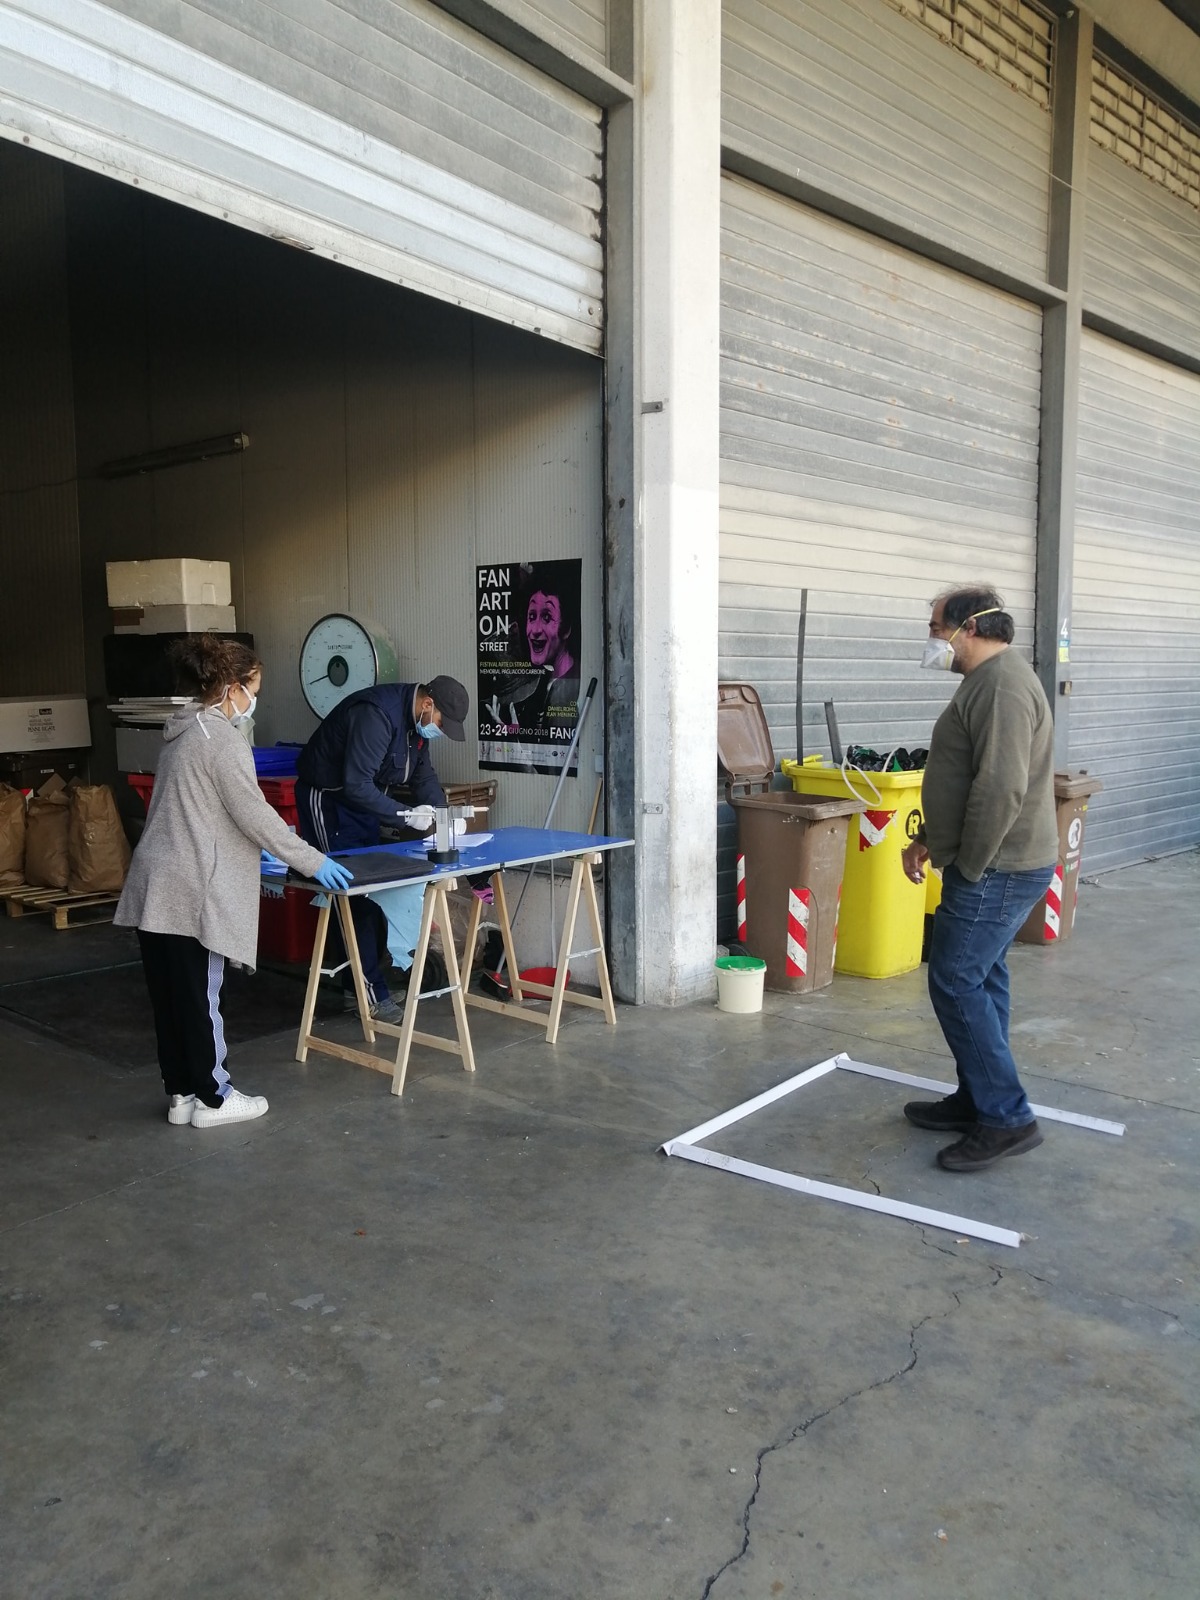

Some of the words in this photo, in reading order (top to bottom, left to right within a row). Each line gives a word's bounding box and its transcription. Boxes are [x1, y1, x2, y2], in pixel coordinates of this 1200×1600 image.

[478, 567, 510, 588] FAN
[479, 591, 512, 611] ART
[479, 614, 509, 635] ON
[1060, 617, 1069, 639] 4
[479, 641, 509, 652] STREET
[508, 726, 534, 735] GIUGNO
[534, 728, 549, 736] 2018
